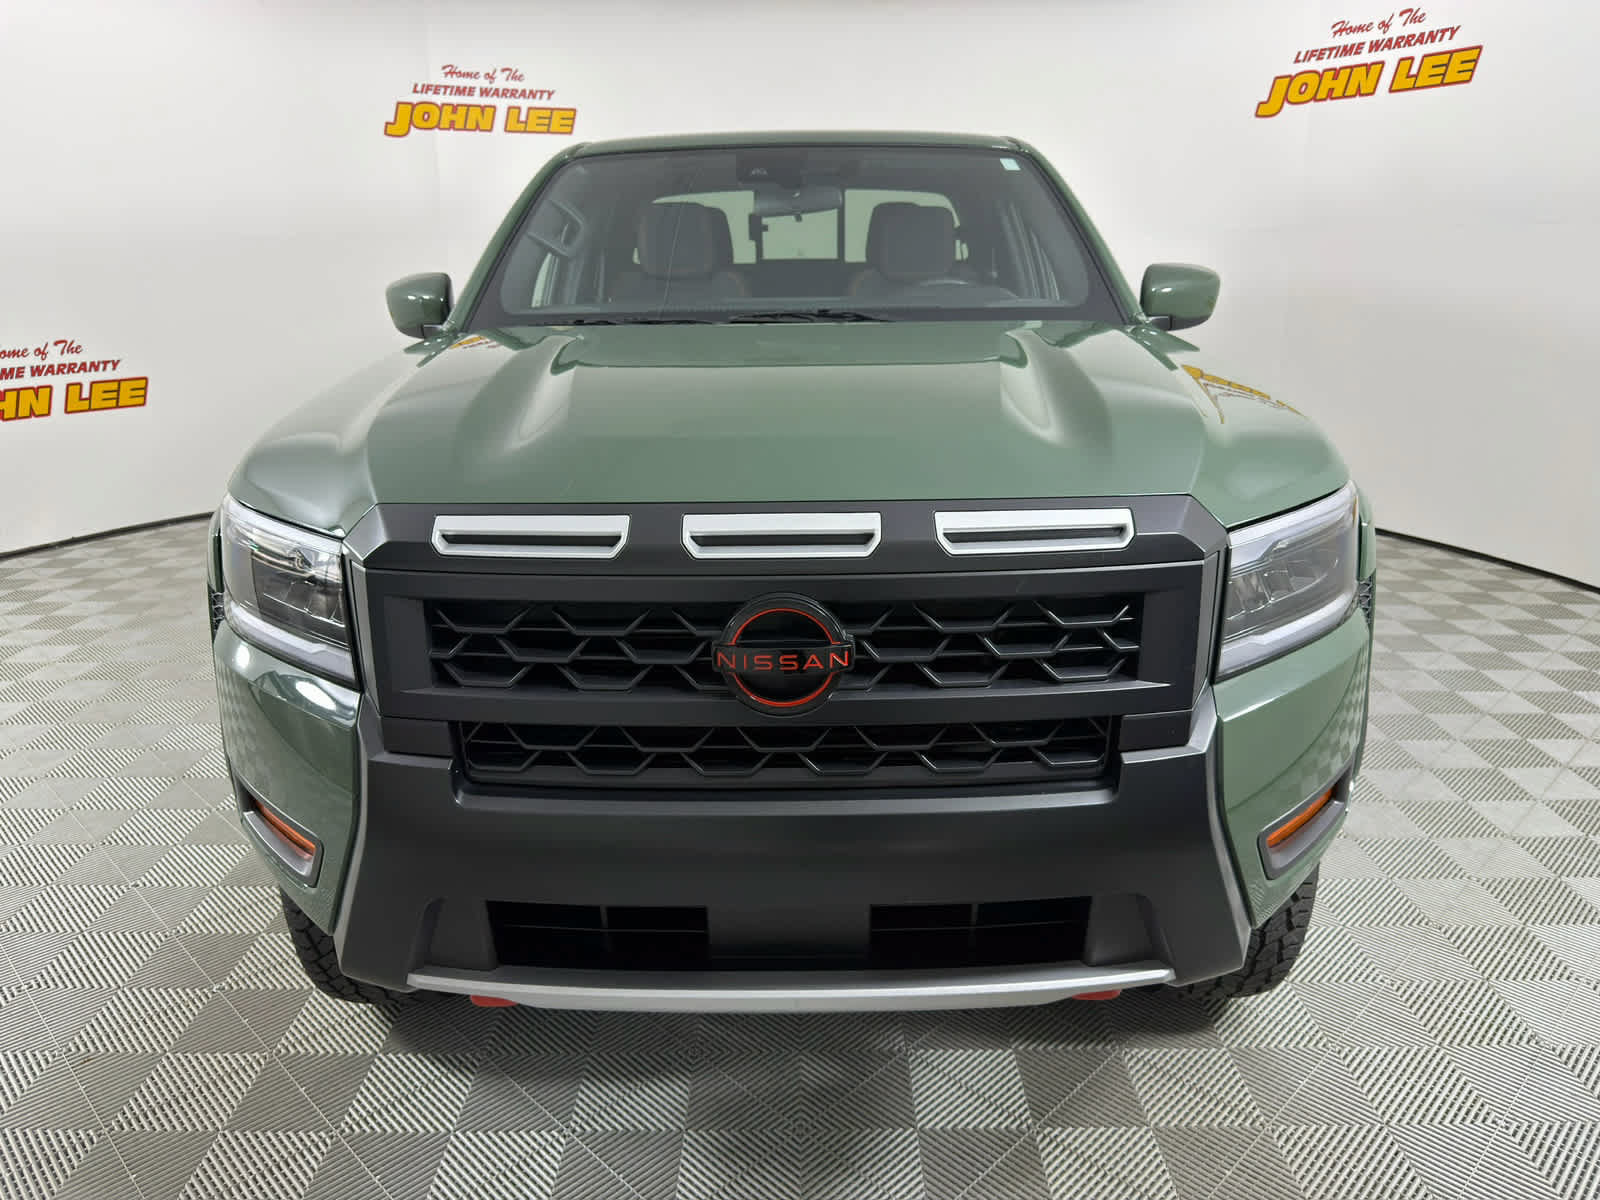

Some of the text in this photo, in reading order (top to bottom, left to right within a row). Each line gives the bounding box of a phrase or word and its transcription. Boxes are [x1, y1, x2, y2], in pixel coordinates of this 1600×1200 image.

[1331, 8, 1426, 38] Home of The
[1293, 26, 1461, 64] LIFETIME WARRANTY
[441, 64, 525, 84] Home of The
[1255, 45, 1483, 118] JOHN LEE
[412, 83, 555, 100] LIFETIME WARRANTY
[384, 101, 576, 138] JOHN LEE
[0, 339, 83, 361] ome of The
[30, 359, 121, 377] WARRANTY
[64, 376, 148, 414] LEE
[716, 651, 849, 671] NISSAN
